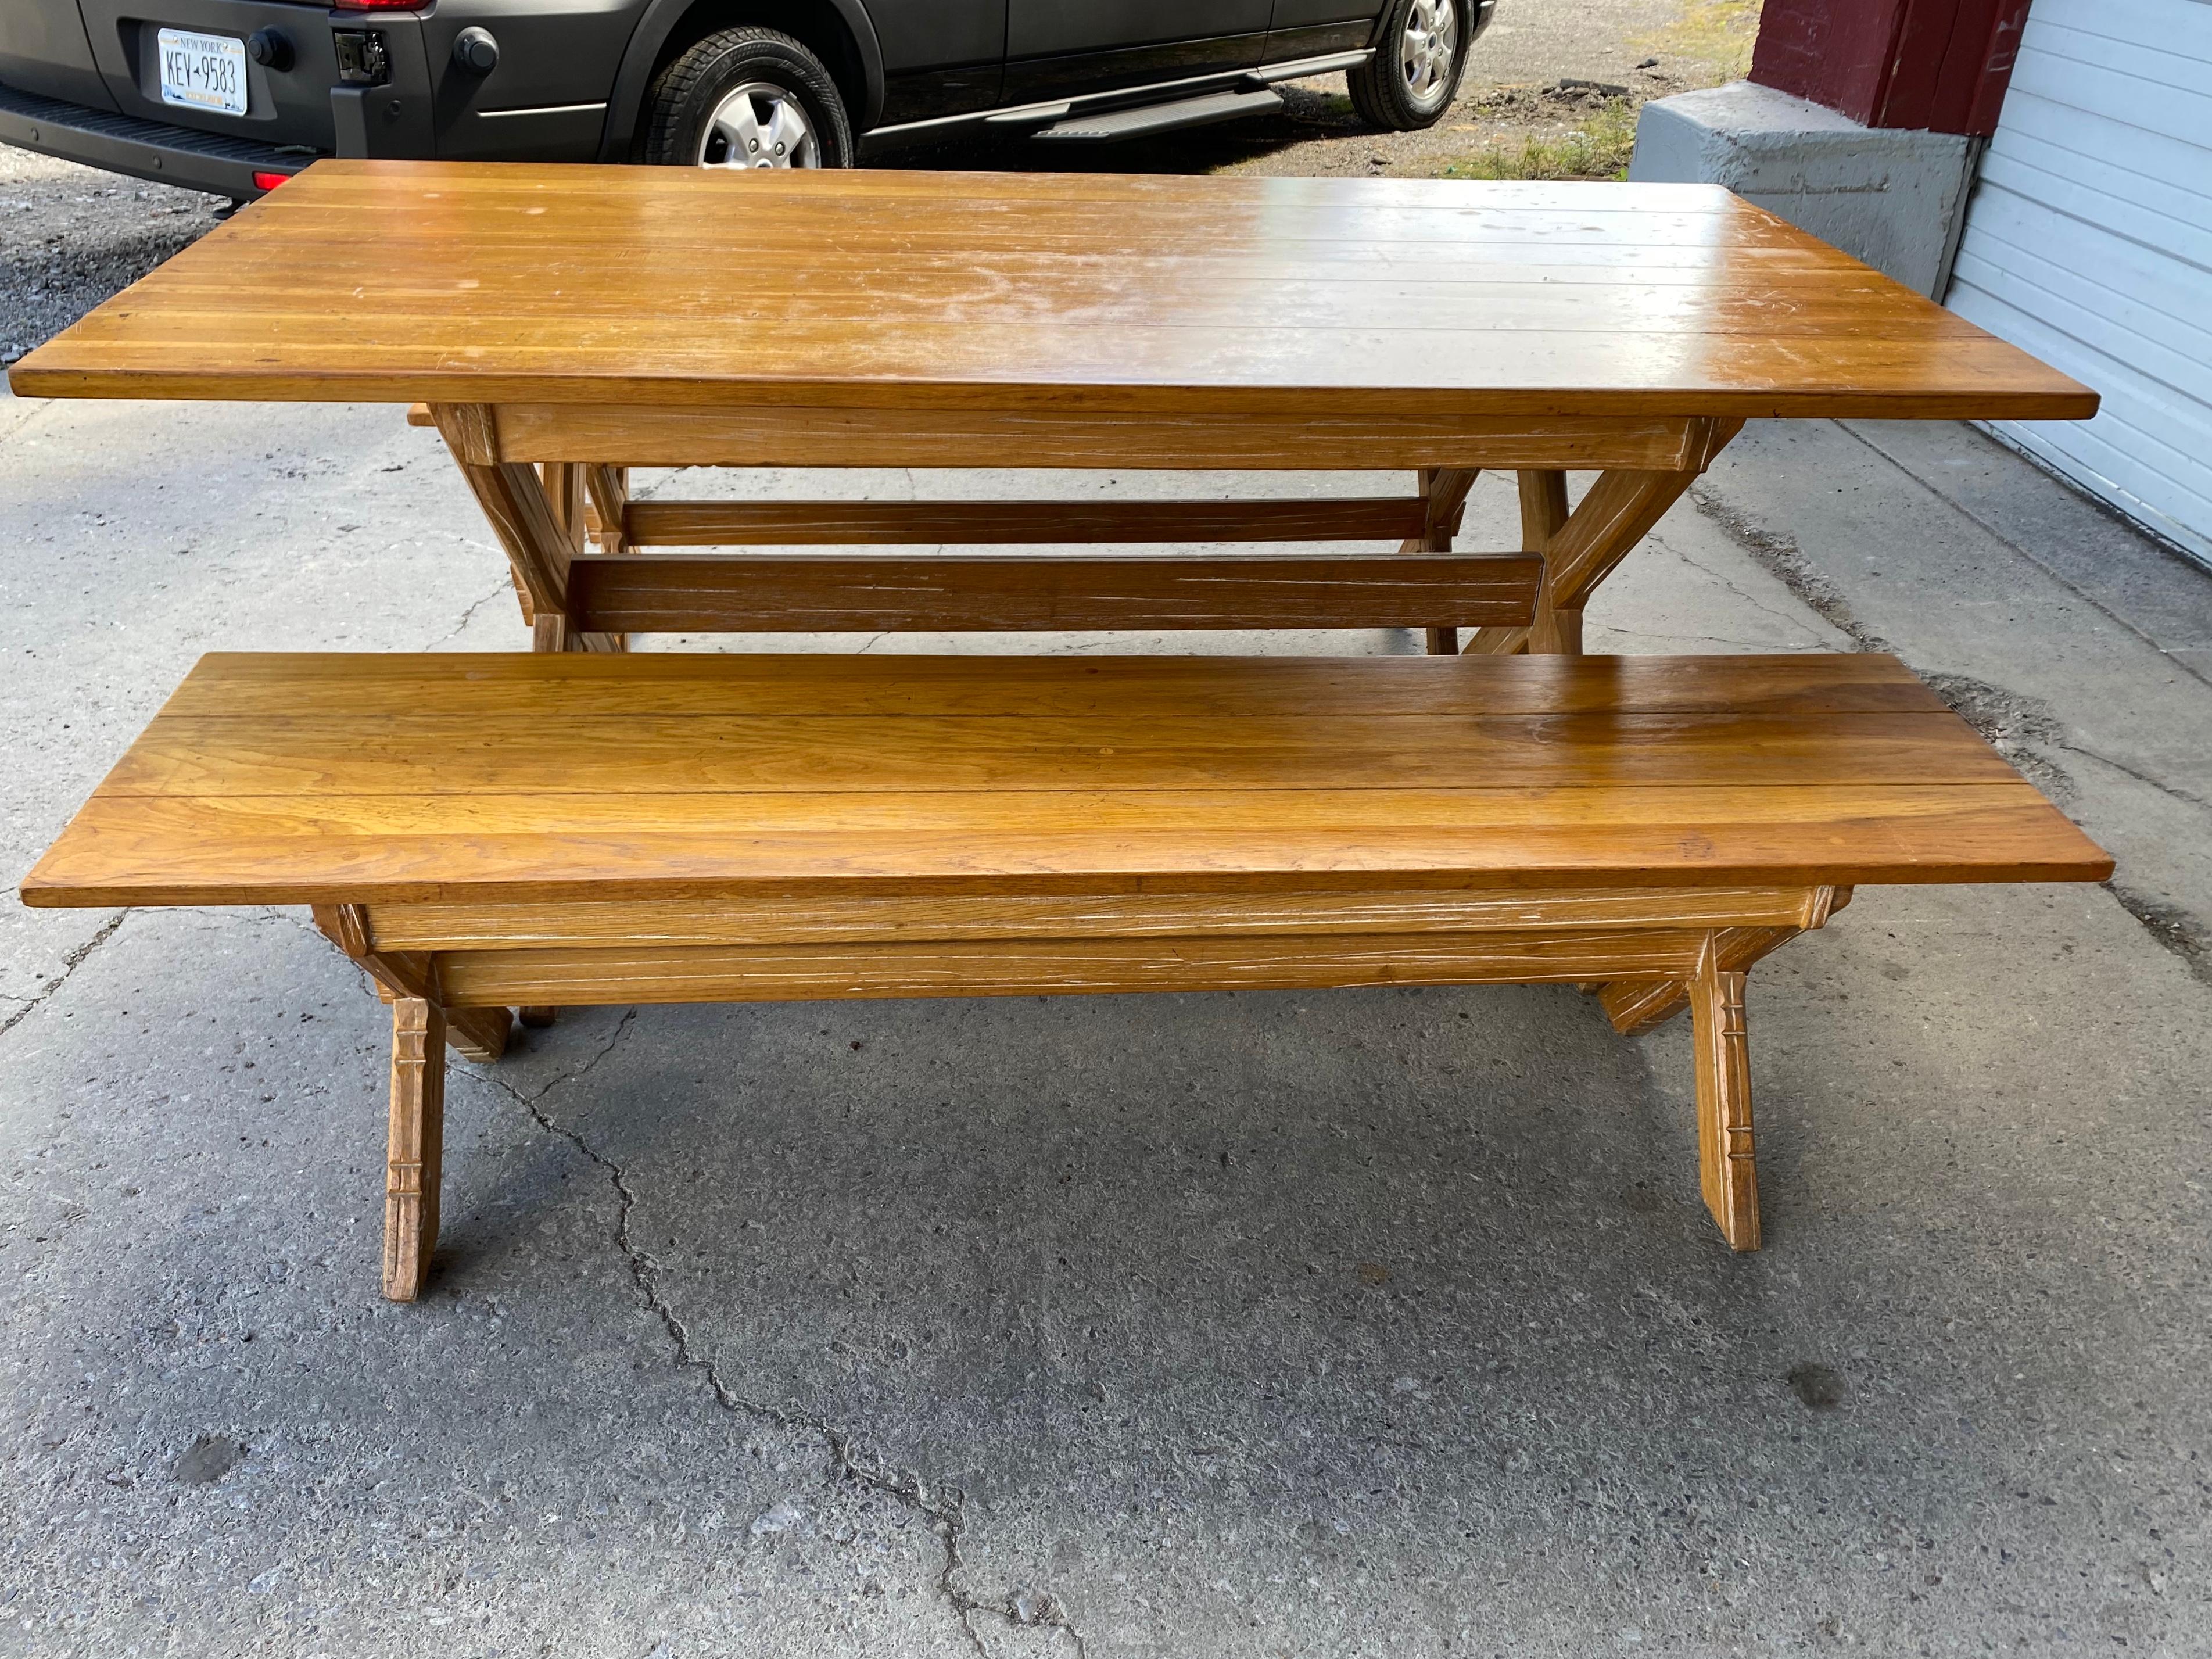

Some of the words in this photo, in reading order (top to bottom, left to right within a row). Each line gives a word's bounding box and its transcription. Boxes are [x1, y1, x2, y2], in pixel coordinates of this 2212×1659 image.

[180, 37, 199, 51] NEW
[200, 41, 223, 54] YORK
[201, 56, 235, 94] 9583
